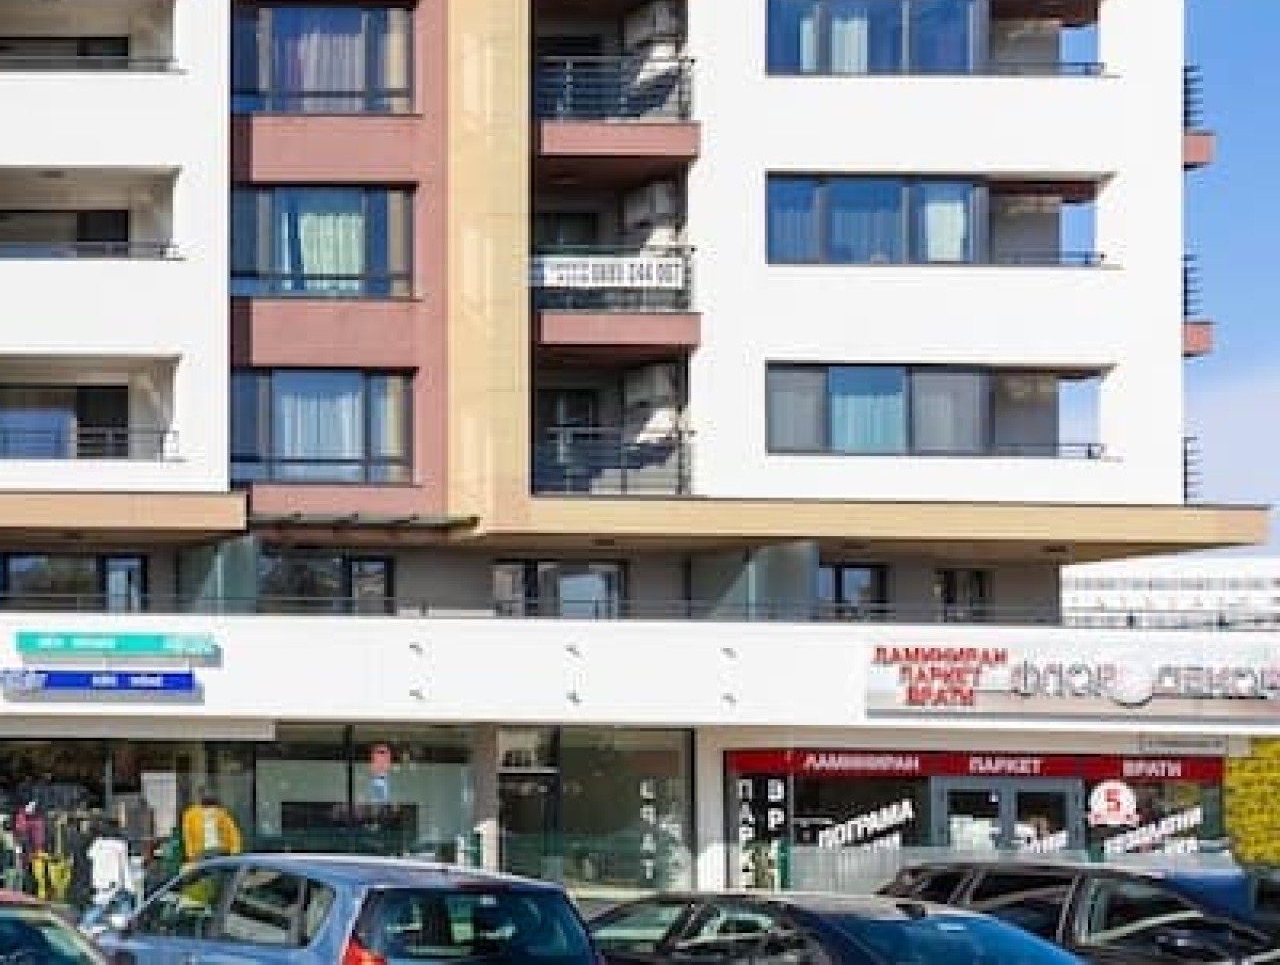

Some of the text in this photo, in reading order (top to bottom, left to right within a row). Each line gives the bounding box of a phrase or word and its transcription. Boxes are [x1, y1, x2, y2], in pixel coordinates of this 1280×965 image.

[873, 646, 1008, 664] ЛАМИНИРАН
[898, 665, 980, 685] ПАРКЕТ
[906, 686, 974, 706] ВРАТИ
[802, 754, 920, 771] ЛАМИНИРАН
[969, 757, 1043, 775] ПАРКЕТ
[1122, 760, 1183, 778] ВРАТИ
[1104, 788, 1122, 812] 5
[737, 778, 755, 894] ПАРКЕ
